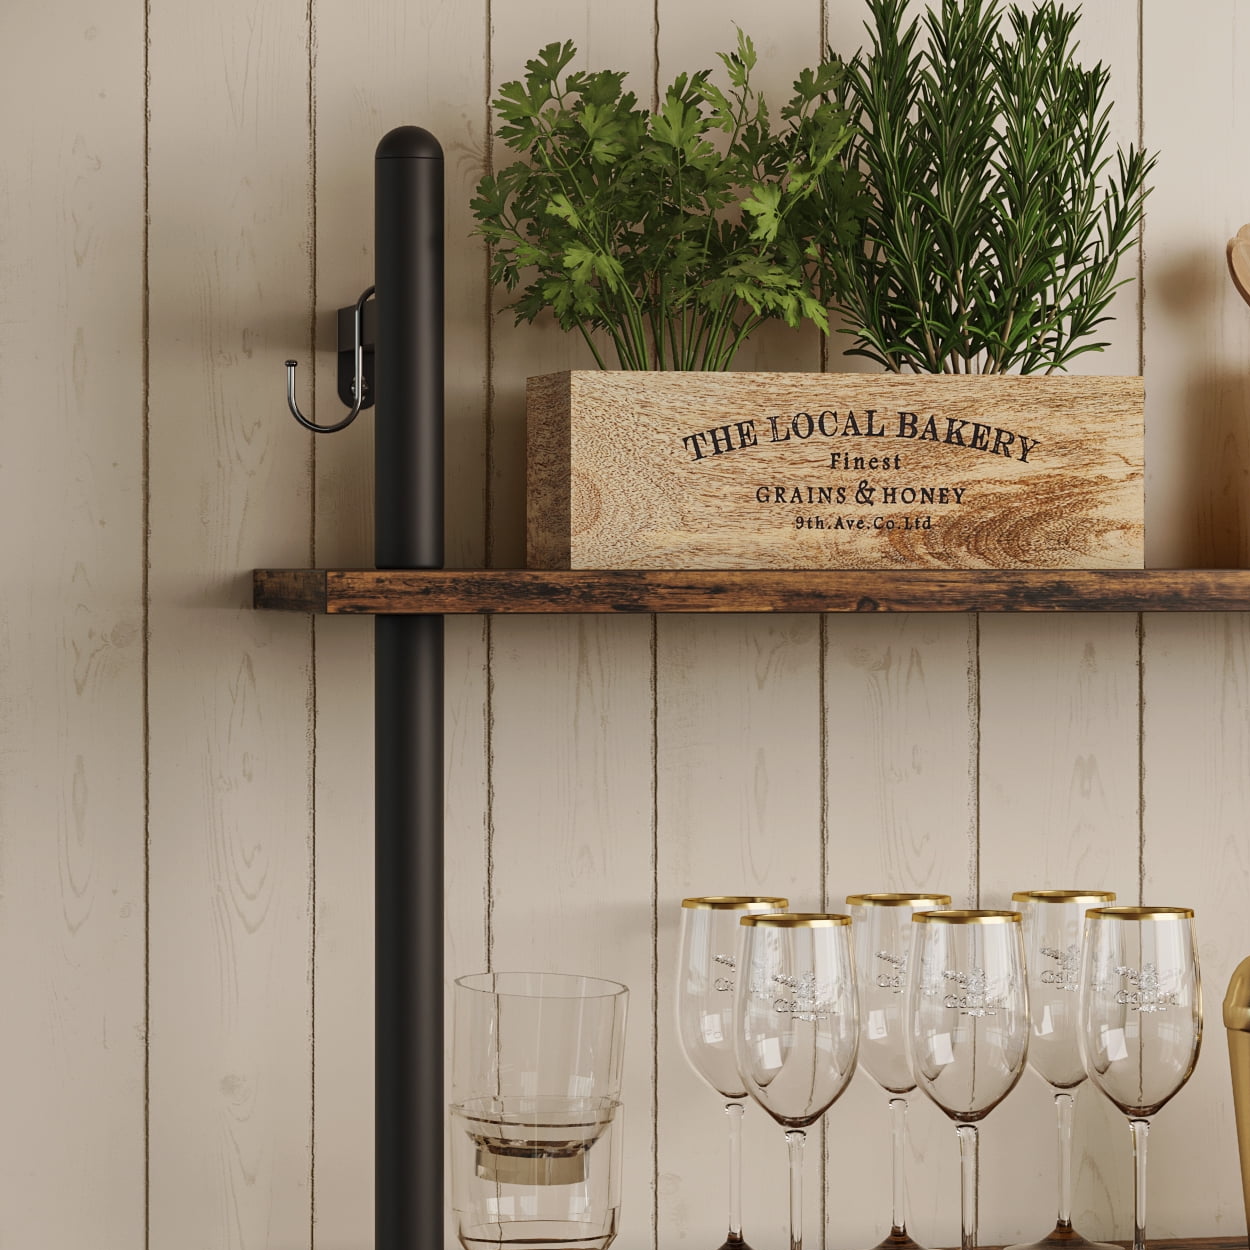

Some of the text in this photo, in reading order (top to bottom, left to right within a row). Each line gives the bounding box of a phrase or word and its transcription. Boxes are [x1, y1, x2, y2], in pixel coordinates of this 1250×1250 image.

[683, 409, 1042, 464] THE LOCAL BAKERY
[829, 452, 901, 471] Finest
[755, 479, 967, 507] GRAINS & HONEY
[795, 516, 932, 530] 9th.Ave.Co.Ltd
